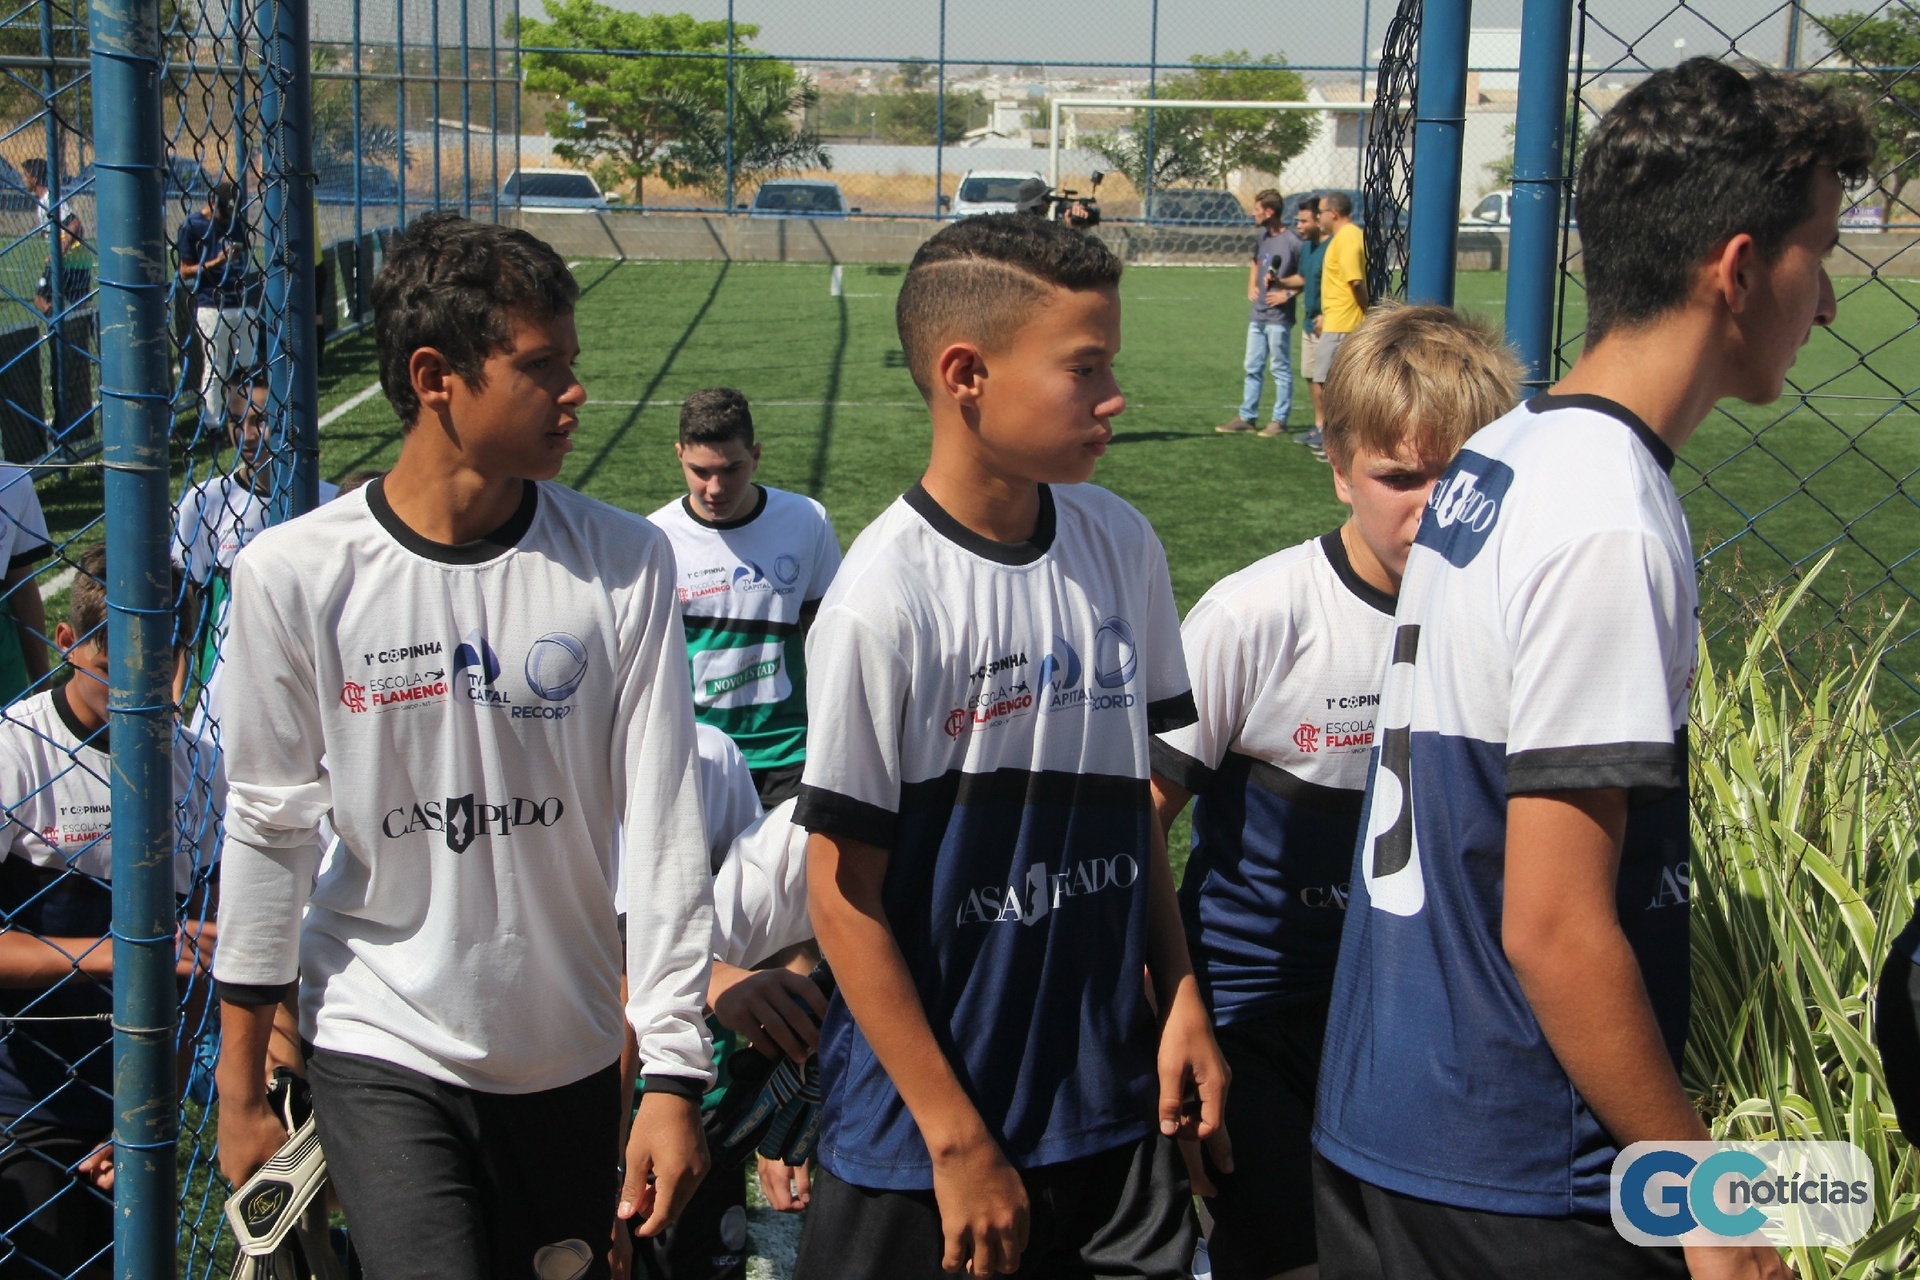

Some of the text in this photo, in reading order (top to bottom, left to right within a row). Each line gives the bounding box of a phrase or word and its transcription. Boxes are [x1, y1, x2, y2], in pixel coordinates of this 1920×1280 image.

[692, 584, 731, 598] FLAMENGO
[743, 583, 771, 591] CAPITAL
[378, 641, 443, 664] COPINHA
[370, 672, 423, 692] ESCOLA
[467, 673, 483, 686] TV
[714, 676, 742, 693] NOVO
[1050, 688, 1094, 707] APITAL
[1326, 720, 1375, 734] ESCOLA
[1326, 732, 1374, 747] FLAME
[70, 805, 111, 815] COPINHA
[63, 823, 98, 833] ESCOLA
[956, 885, 1024, 929] ASA
